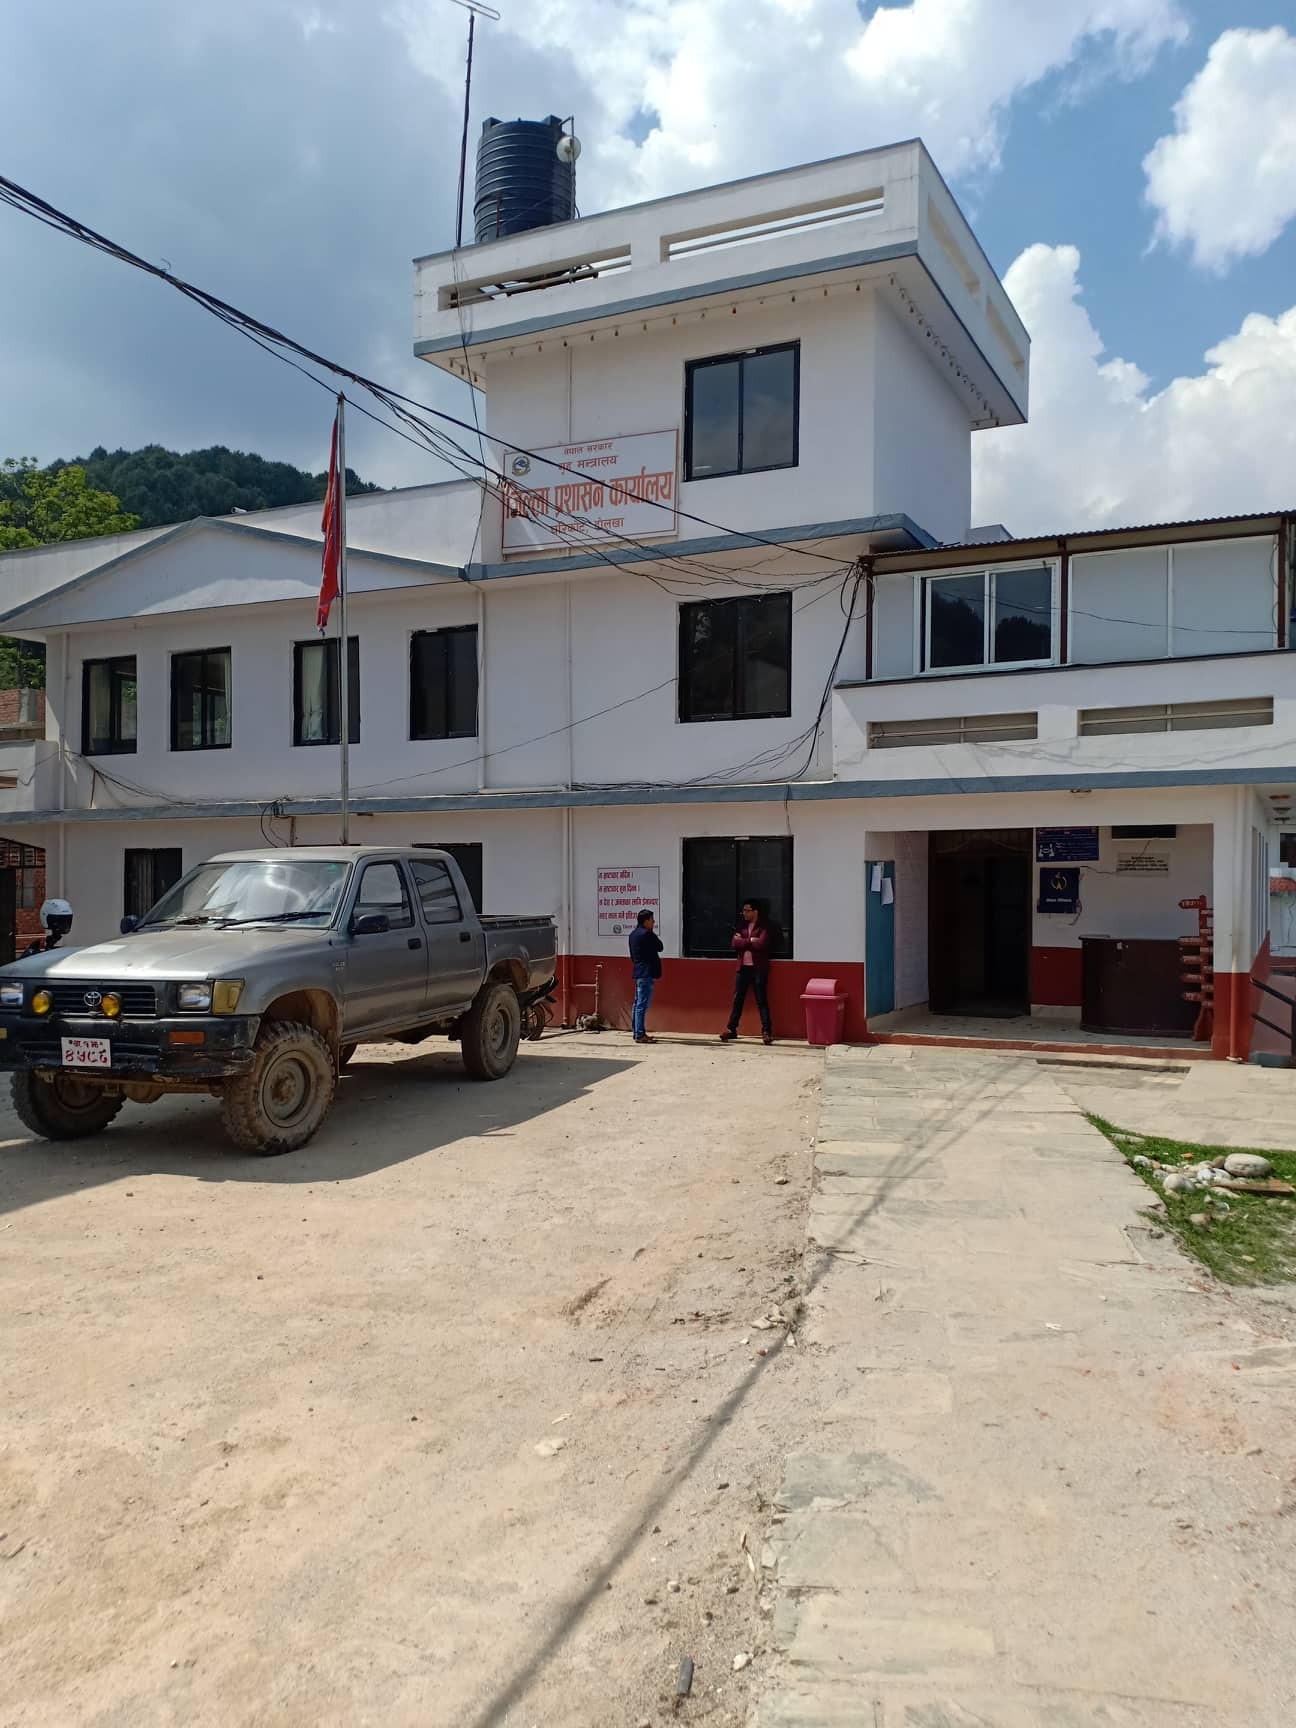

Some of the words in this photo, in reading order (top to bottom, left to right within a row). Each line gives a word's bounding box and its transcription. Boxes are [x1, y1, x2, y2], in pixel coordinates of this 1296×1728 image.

[577, 455, 619, 469] मन्त्रालय
[554, 481, 606, 518] प्रशासन
[609, 466, 674, 507] कार्यालय
